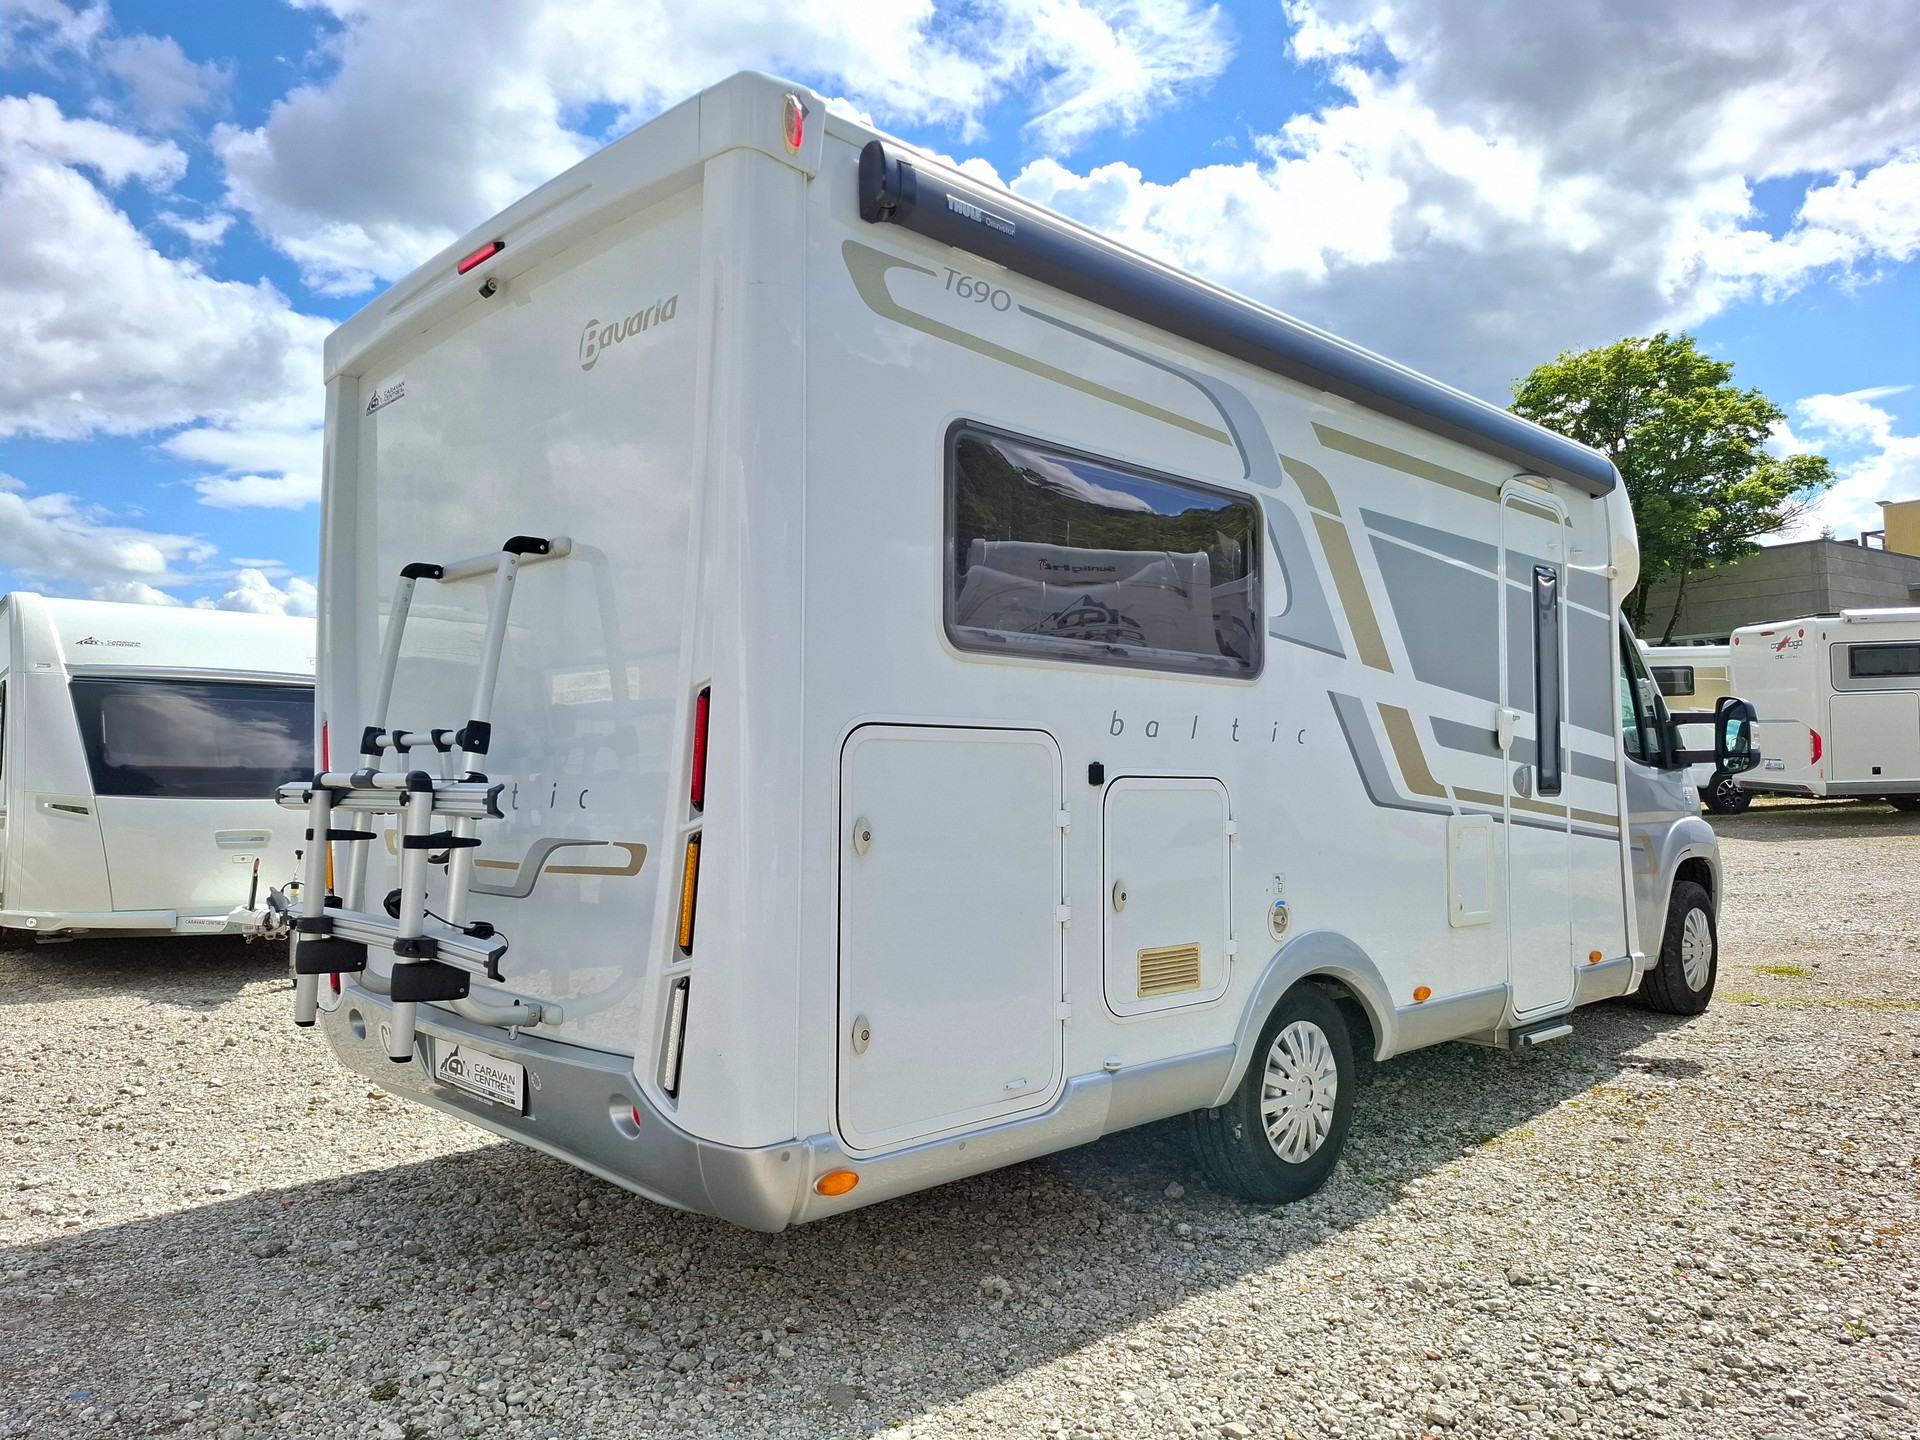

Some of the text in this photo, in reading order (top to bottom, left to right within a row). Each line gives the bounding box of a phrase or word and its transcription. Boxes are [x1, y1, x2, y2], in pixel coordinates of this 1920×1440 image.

[946, 194, 1015, 236] THULE Omnistor
[943, 266, 1011, 312] T690
[579, 294, 678, 371] Bavaria
[1109, 709, 1306, 745] baltic
[512, 782, 589, 810] tic
[474, 1063, 516, 1086] CARAVAN
[474, 1073, 506, 1093] CENTRE
